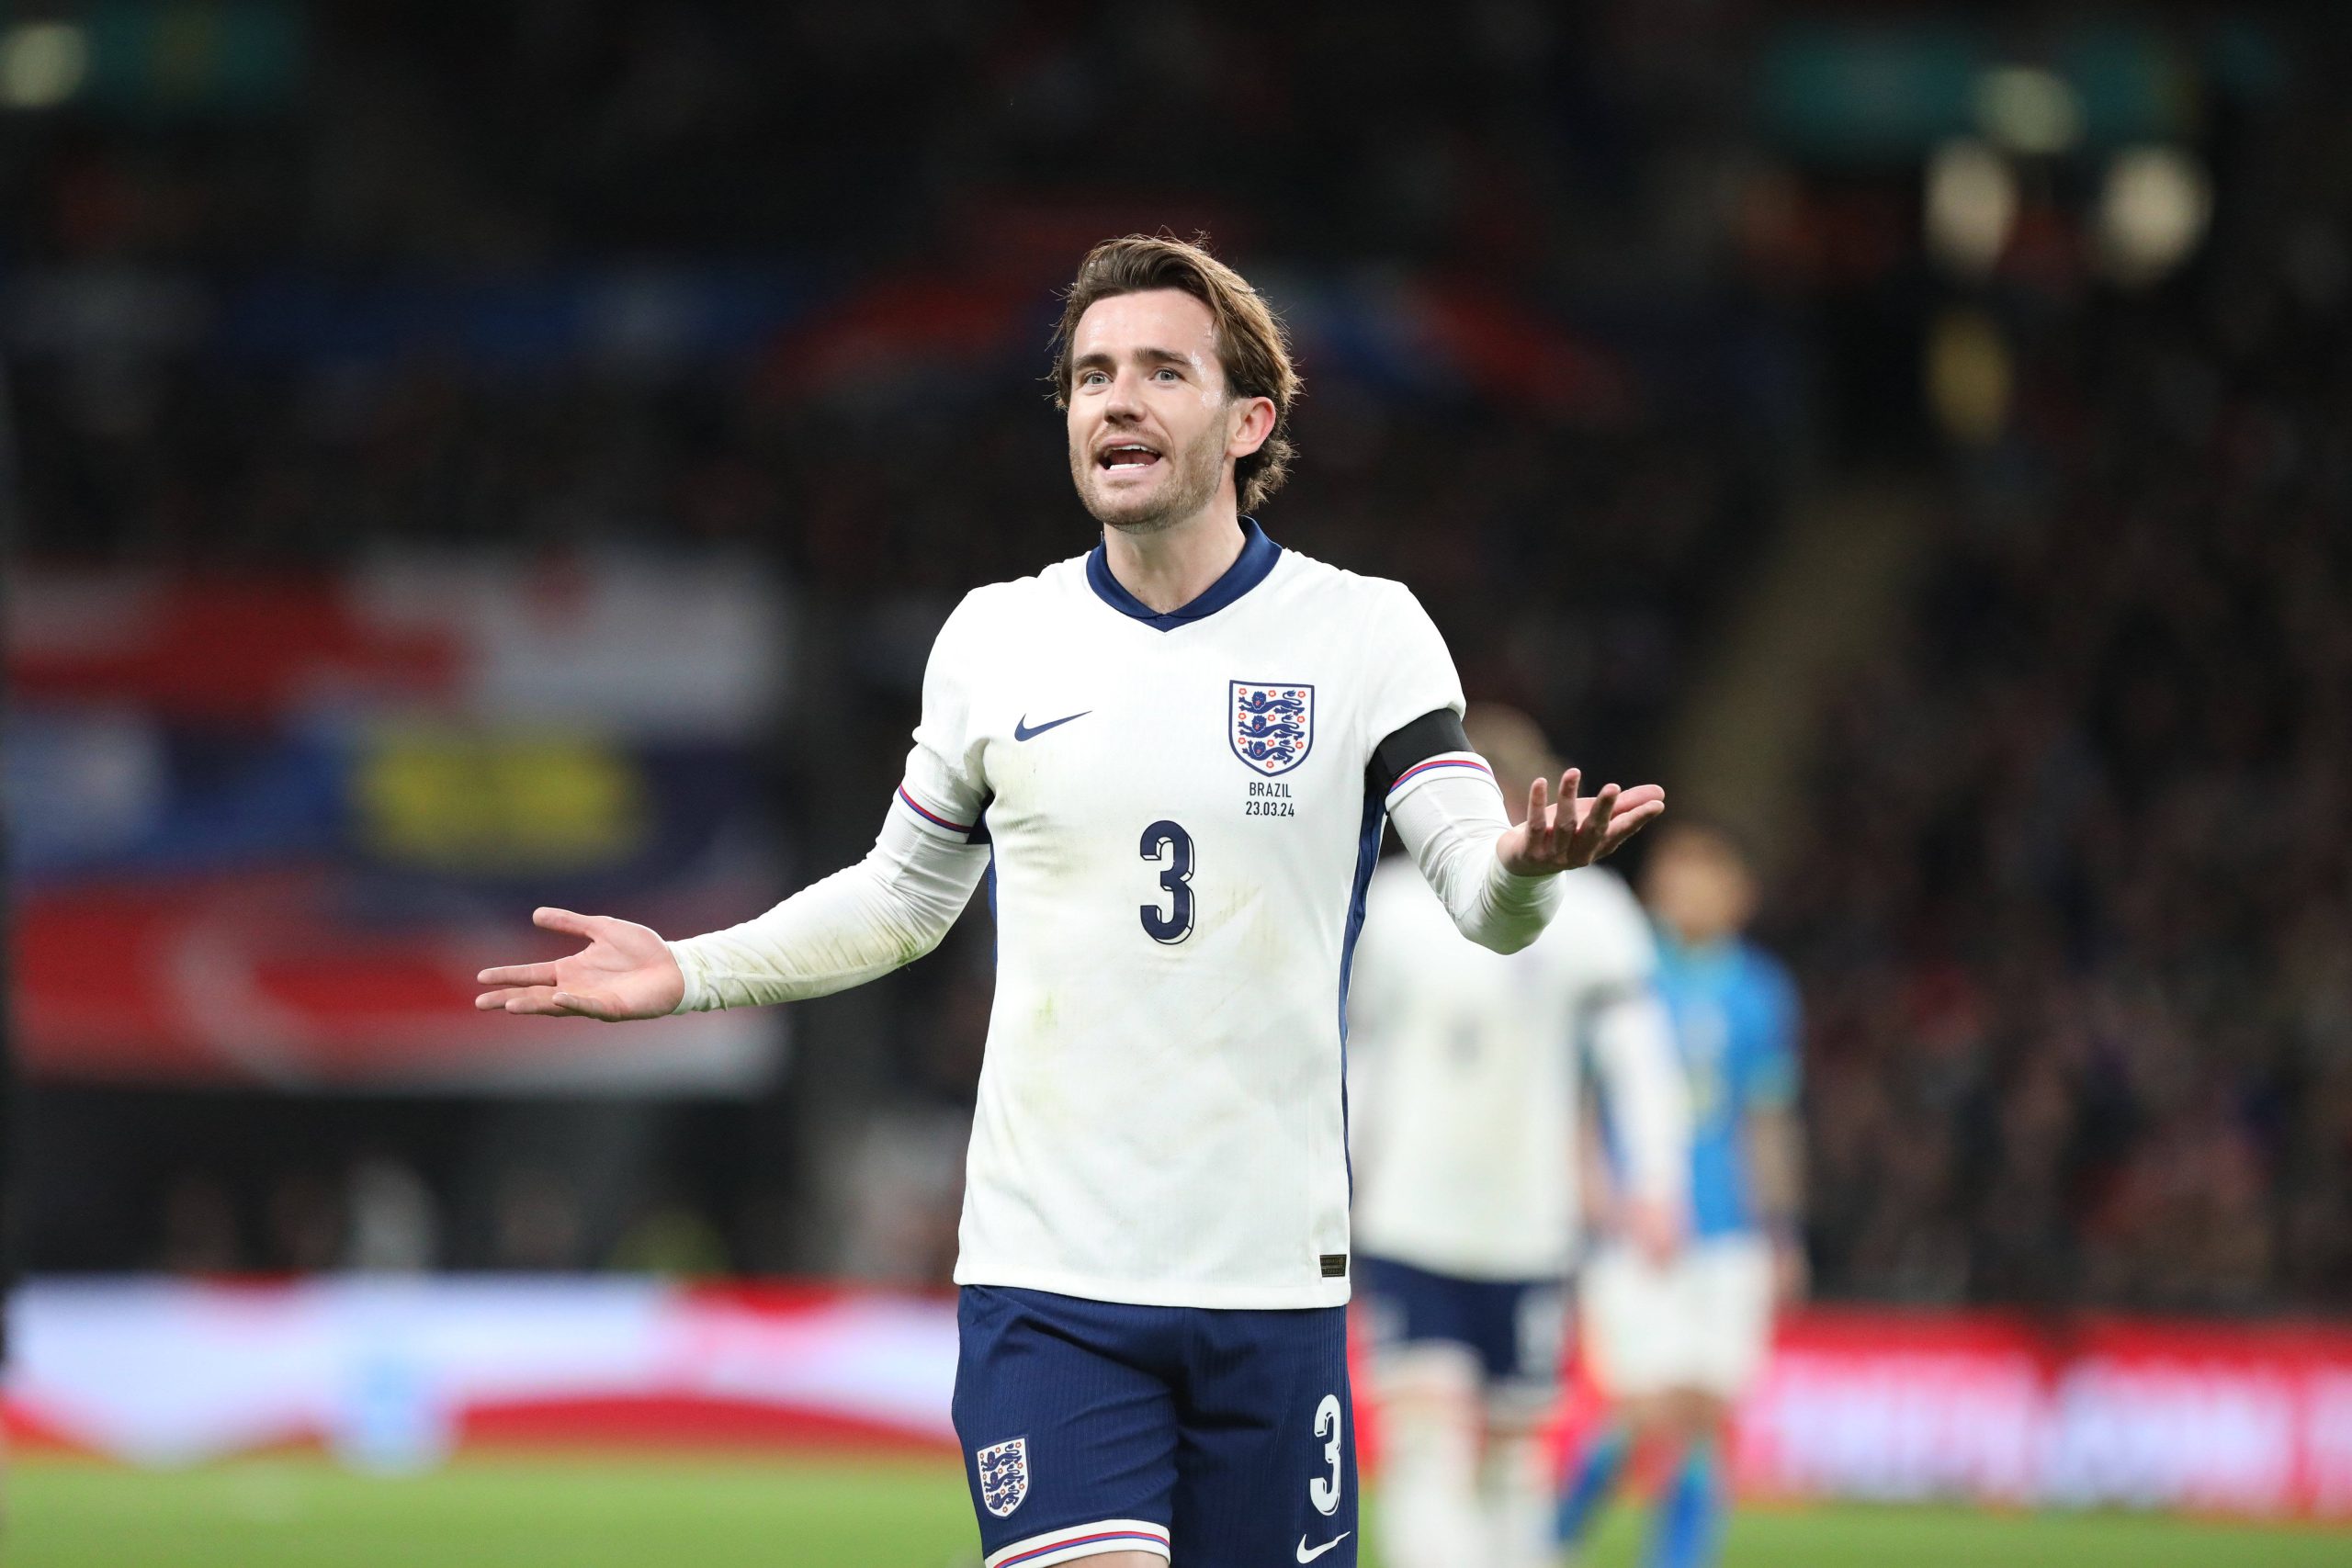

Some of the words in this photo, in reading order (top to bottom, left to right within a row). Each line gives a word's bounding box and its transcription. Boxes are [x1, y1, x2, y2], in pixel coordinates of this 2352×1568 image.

[1246, 801, 1295, 818] 23.03.24
[1250, 782, 1292, 798] BRAZIL
[1140, 820, 1194, 945] 3
[1310, 1393, 1341, 1516] 3
